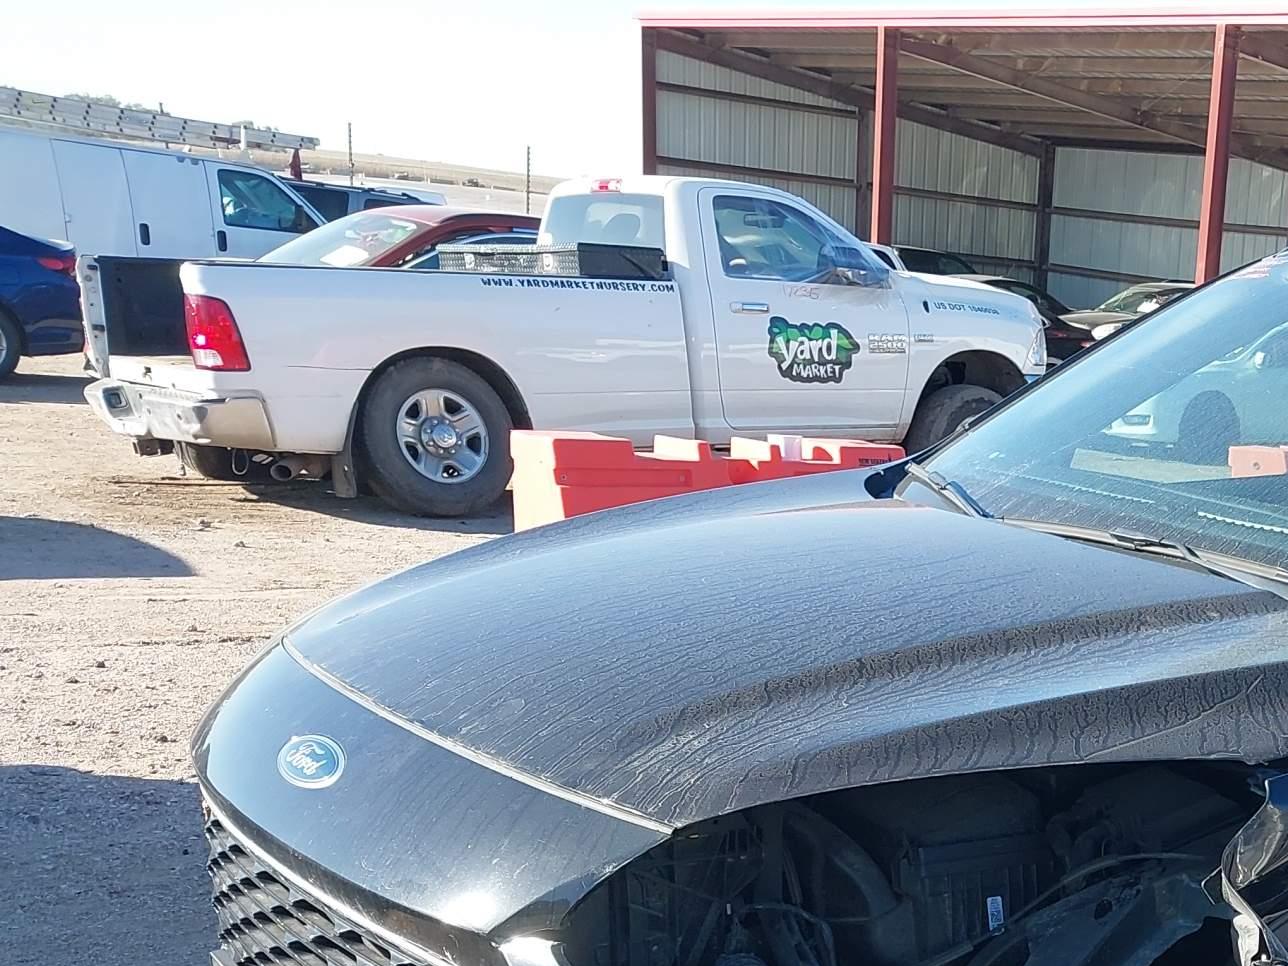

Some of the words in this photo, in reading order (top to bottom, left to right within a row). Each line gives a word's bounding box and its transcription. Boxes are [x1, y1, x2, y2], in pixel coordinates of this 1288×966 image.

[480, 277, 675, 293] WWW.YARDMARKETNURSERY.COM
[933, 301, 947, 310] US
[948, 303, 966, 311] DOT
[776, 329, 838, 370] yard
[792, 363, 842, 379] MARKET
[286, 742, 328, 776] Ford
